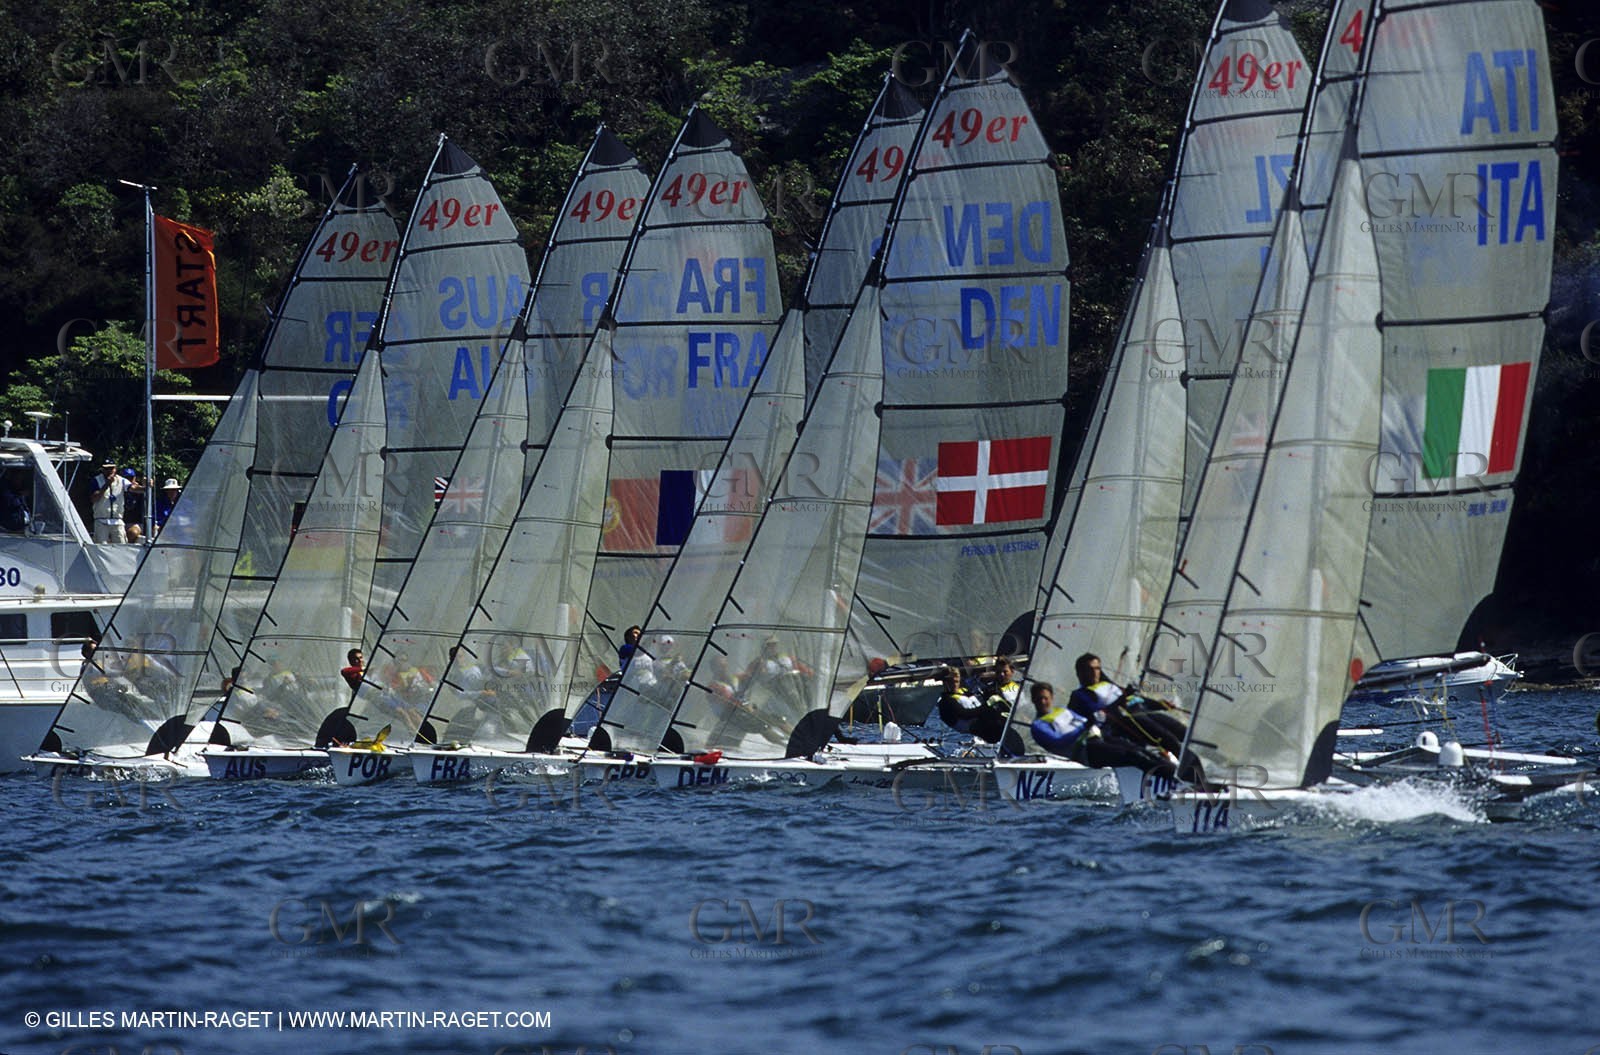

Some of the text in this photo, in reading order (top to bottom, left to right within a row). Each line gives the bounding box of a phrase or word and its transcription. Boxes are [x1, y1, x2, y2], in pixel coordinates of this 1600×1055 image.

[1208, 52, 1302, 96] 49er
[932, 107, 1028, 148] 49er
[570, 189, 645, 224] 49e
[661, 172, 748, 208] 49er
[1476, 159, 1547, 247] ITA
[419, 197, 499, 232] 49er
[316, 231, 398, 263] 49er
[960, 284, 1062, 350] DEN
[687, 331, 768, 388] FRA
[224, 757, 268, 779] AUS
[347, 754, 393, 779] POR
[430, 756, 472, 781] FRA
[1015, 769, 1058, 802] NZL
